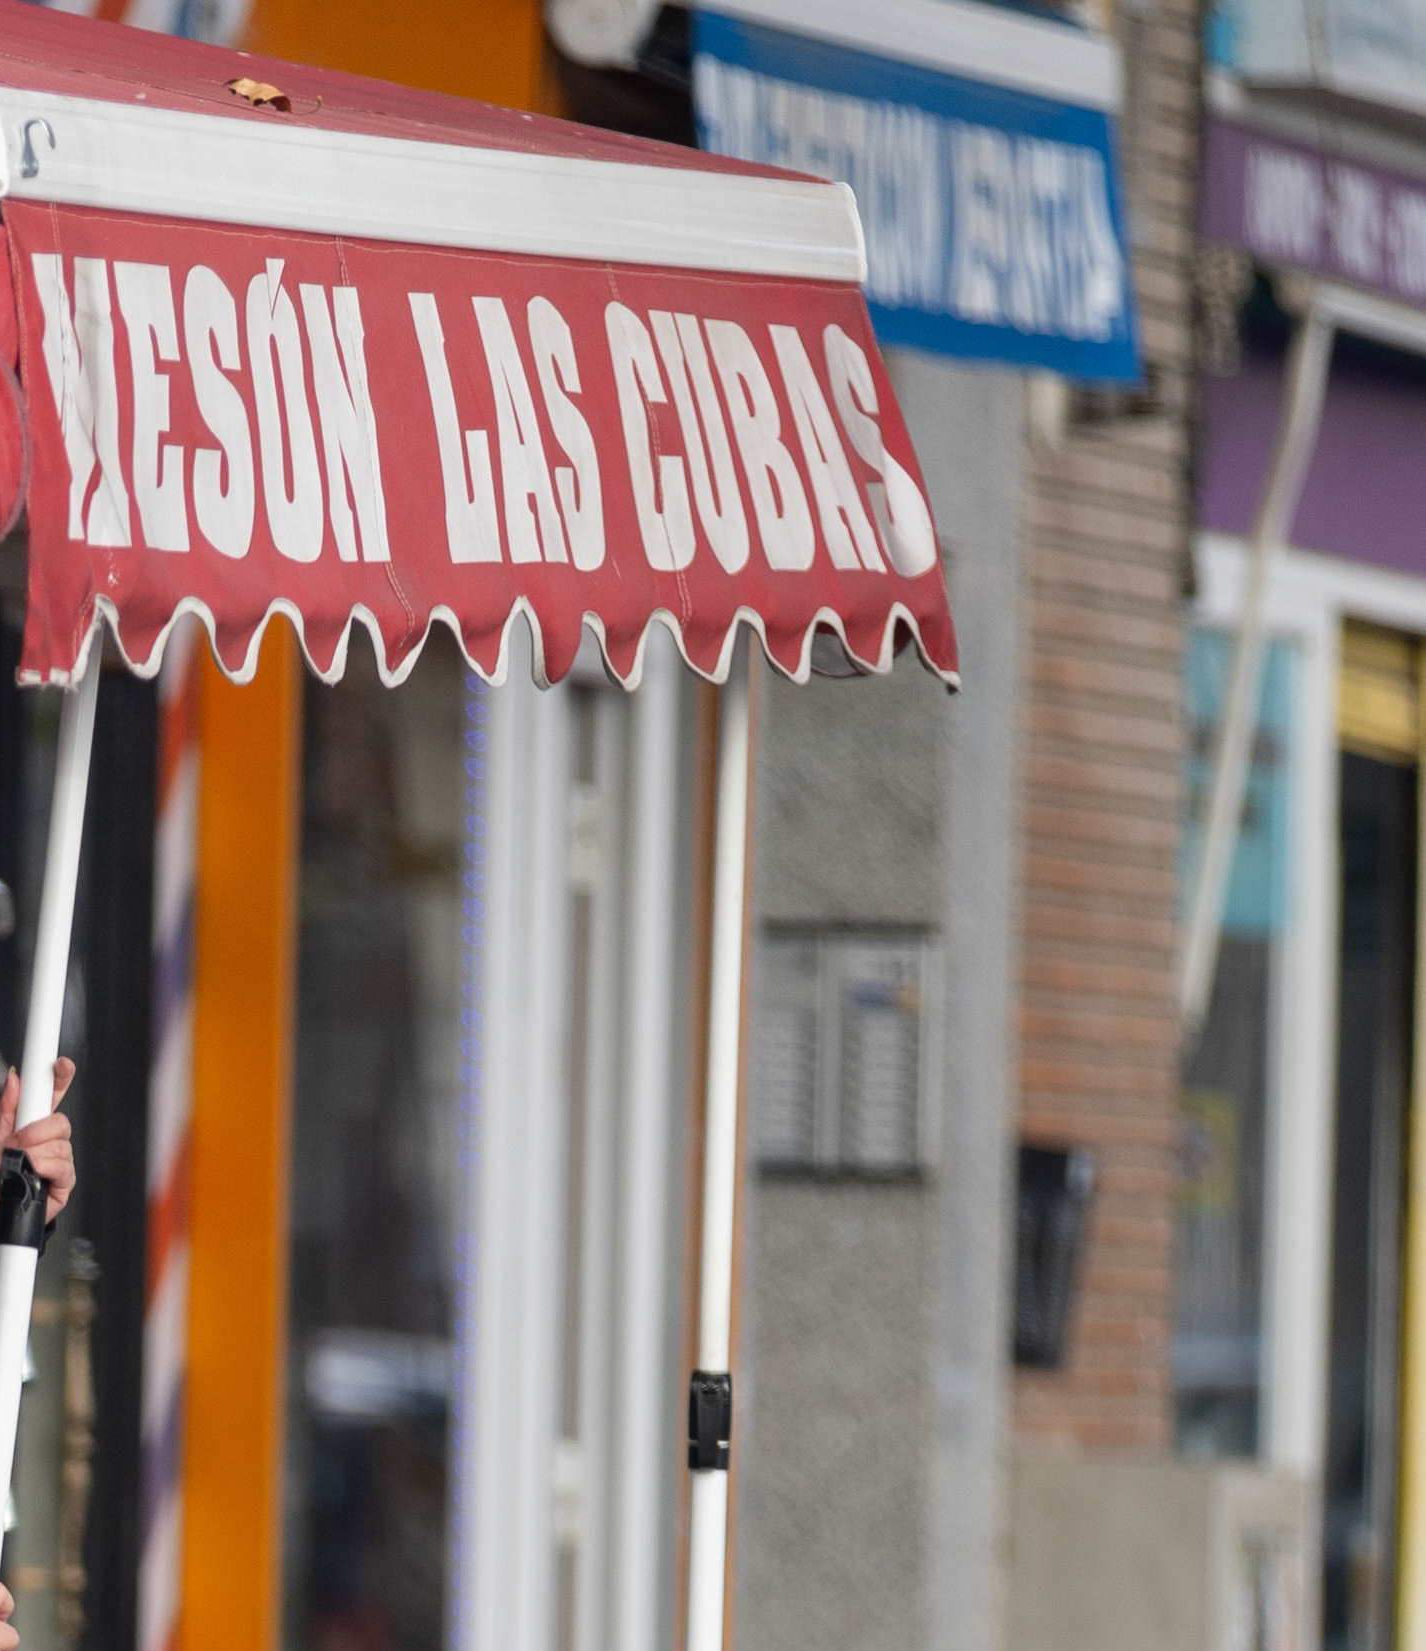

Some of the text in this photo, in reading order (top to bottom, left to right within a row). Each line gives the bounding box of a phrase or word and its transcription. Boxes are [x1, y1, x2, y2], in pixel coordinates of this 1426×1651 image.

[31, 253, 937, 578] MESÓN LAS CUBAS
